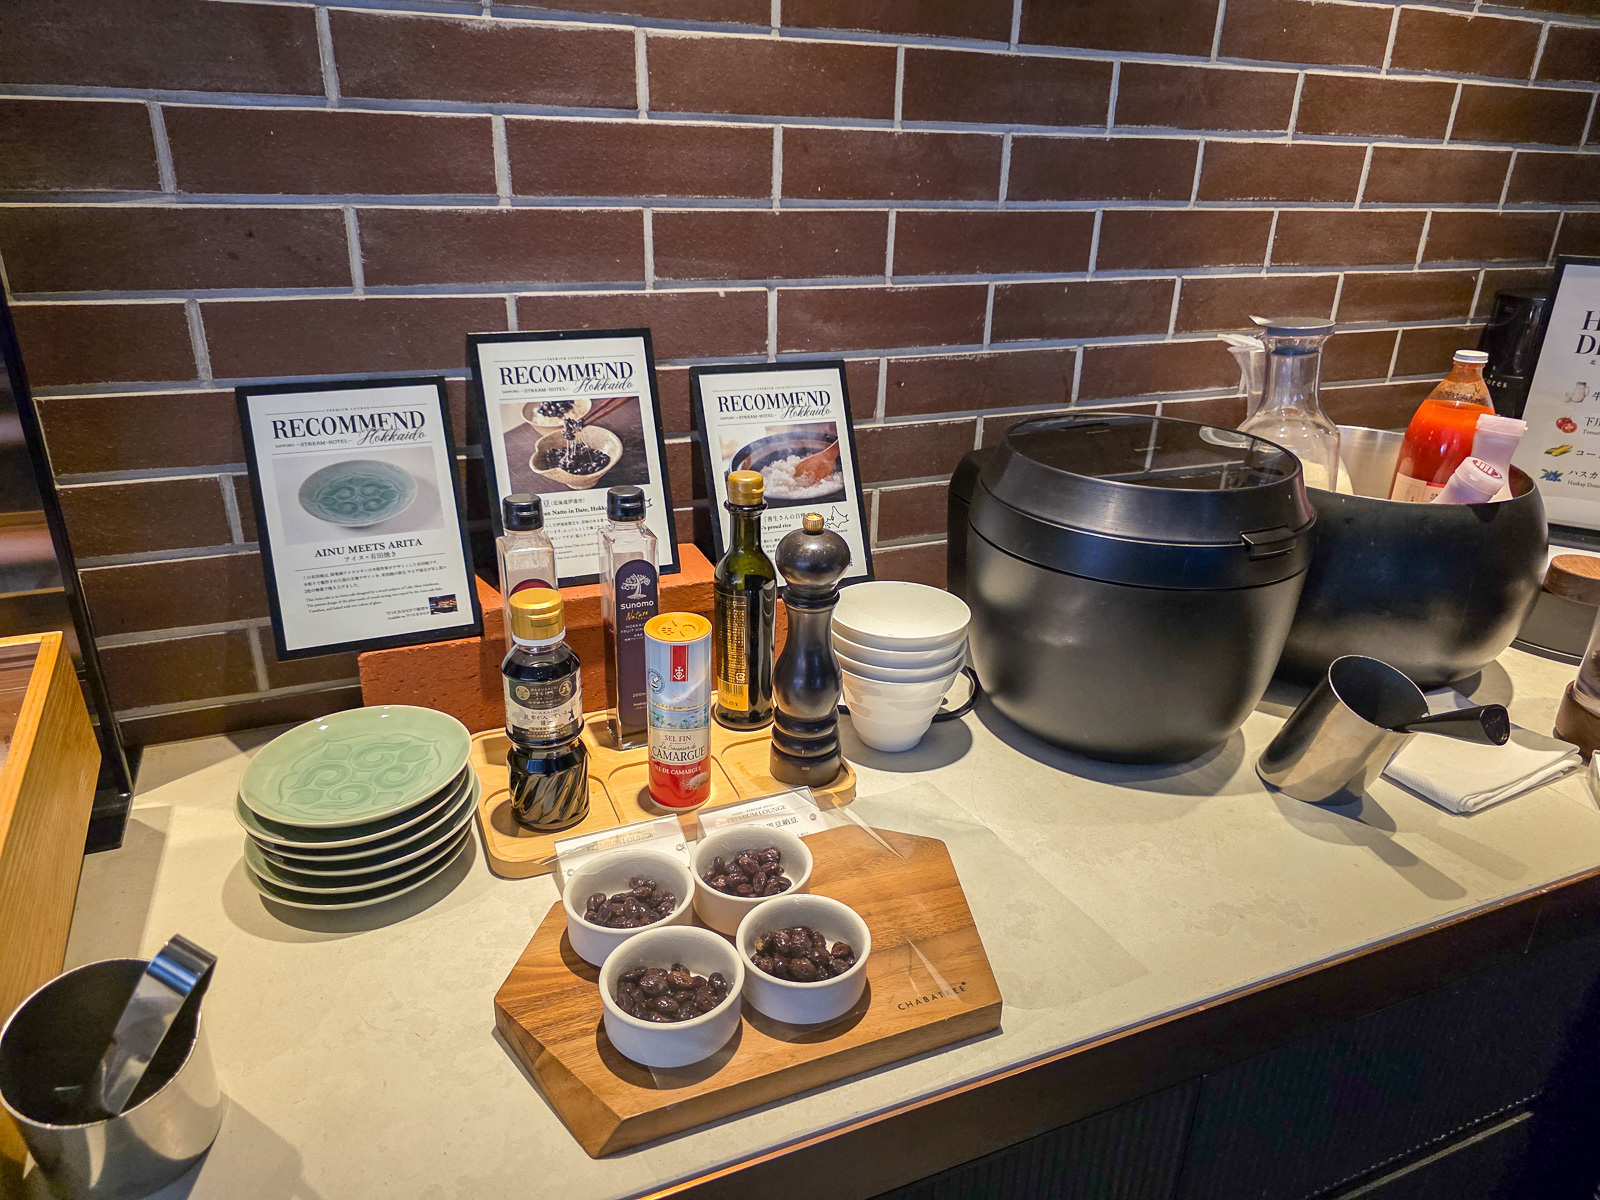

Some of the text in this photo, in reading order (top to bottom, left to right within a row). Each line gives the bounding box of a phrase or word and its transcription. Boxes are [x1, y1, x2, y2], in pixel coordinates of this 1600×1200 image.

[499, 361, 634, 386] RECOMMEND
[572, 375, 634, 394] Hokkaido
[717, 390, 831, 412] RECOMMEND
[780, 405, 831, 420] Hokkaido
[271, 410, 426, 440] RECOMMEND
[356, 428, 428, 446] Hokkaido
[552, 508, 568, 516] Natto
[314, 538, 423, 558] AINU MEETS ARITA
[651, 745, 706, 762] CAMARGUE
[758, 804, 787, 818] LOUNGE
[897, 984, 967, 1011] CHABATREE
